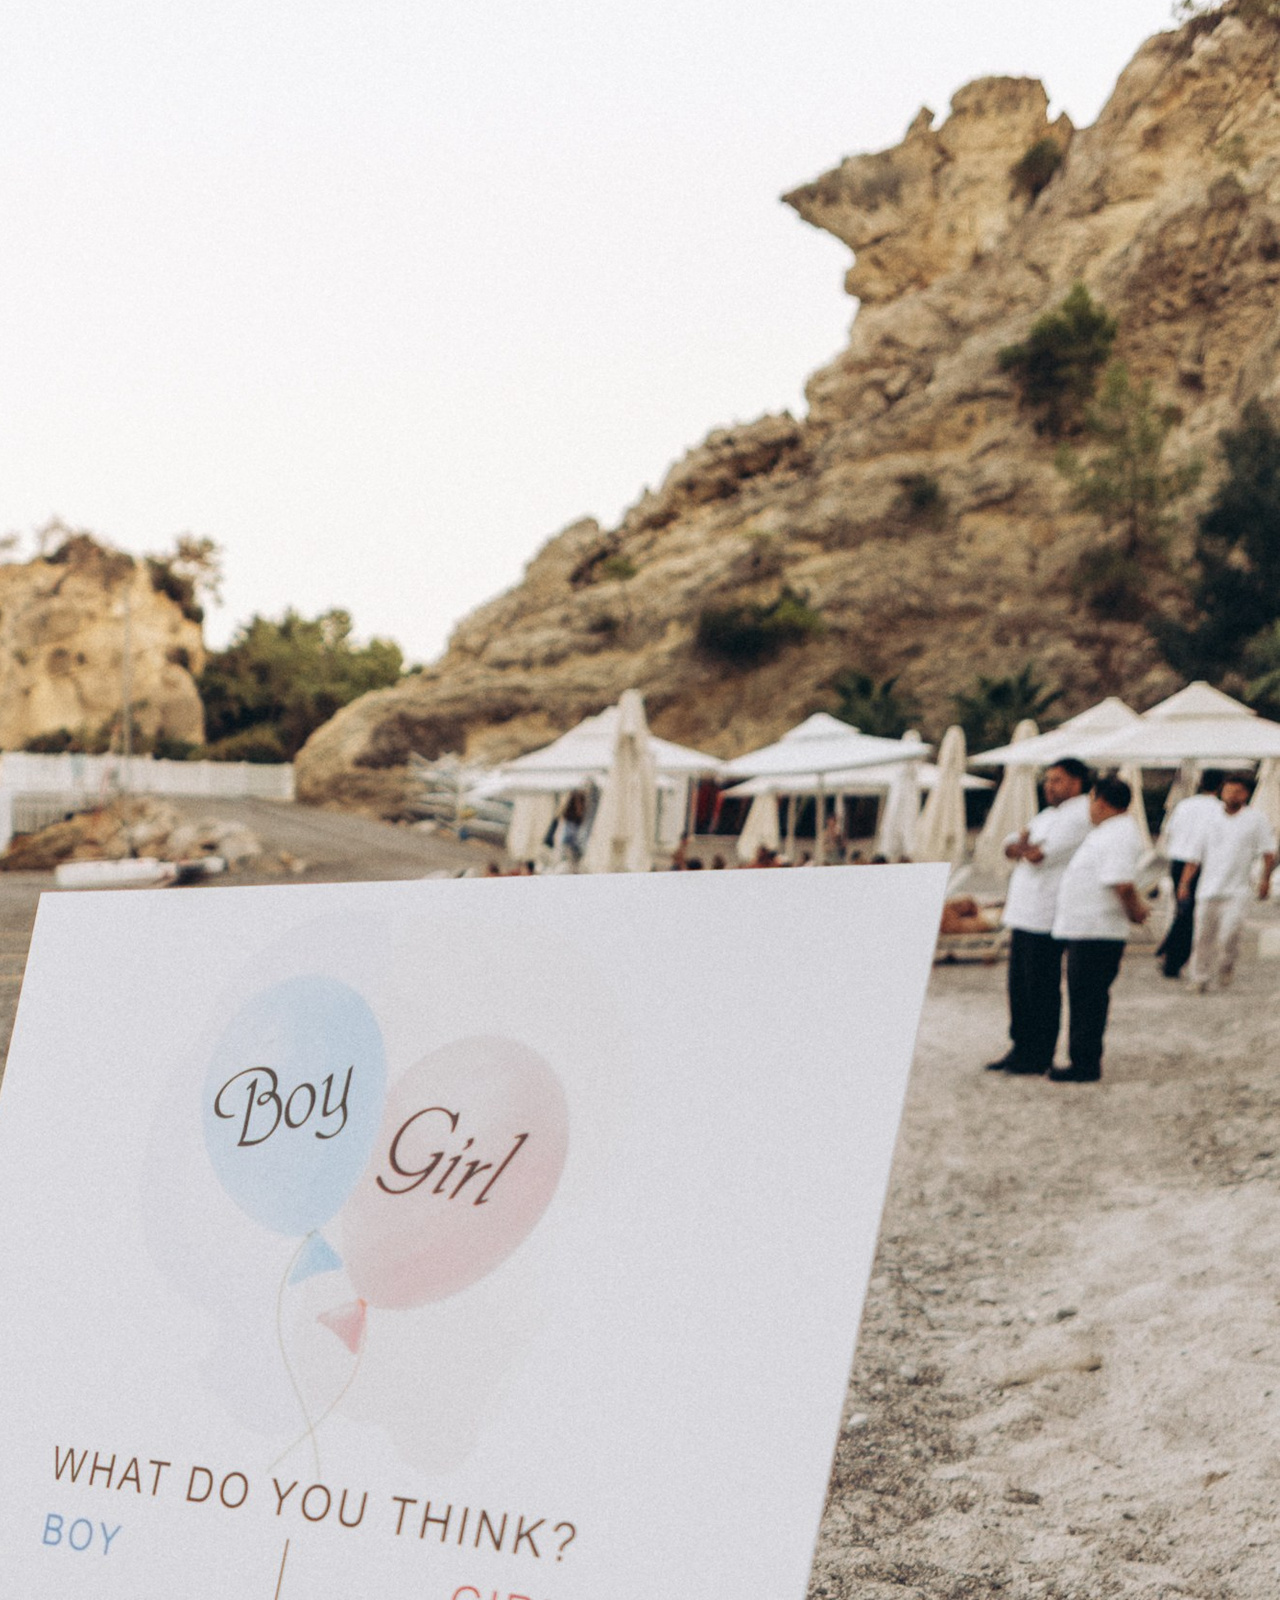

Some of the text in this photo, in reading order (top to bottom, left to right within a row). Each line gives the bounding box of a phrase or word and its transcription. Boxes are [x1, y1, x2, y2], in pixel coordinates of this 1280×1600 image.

[213, 1064, 355, 1148] Boy
[375, 1106, 530, 1207] Girl
[41, 1512, 123, 1557] BOY
[53, 1444, 578, 1562] WHAT DO YOU THINK?
